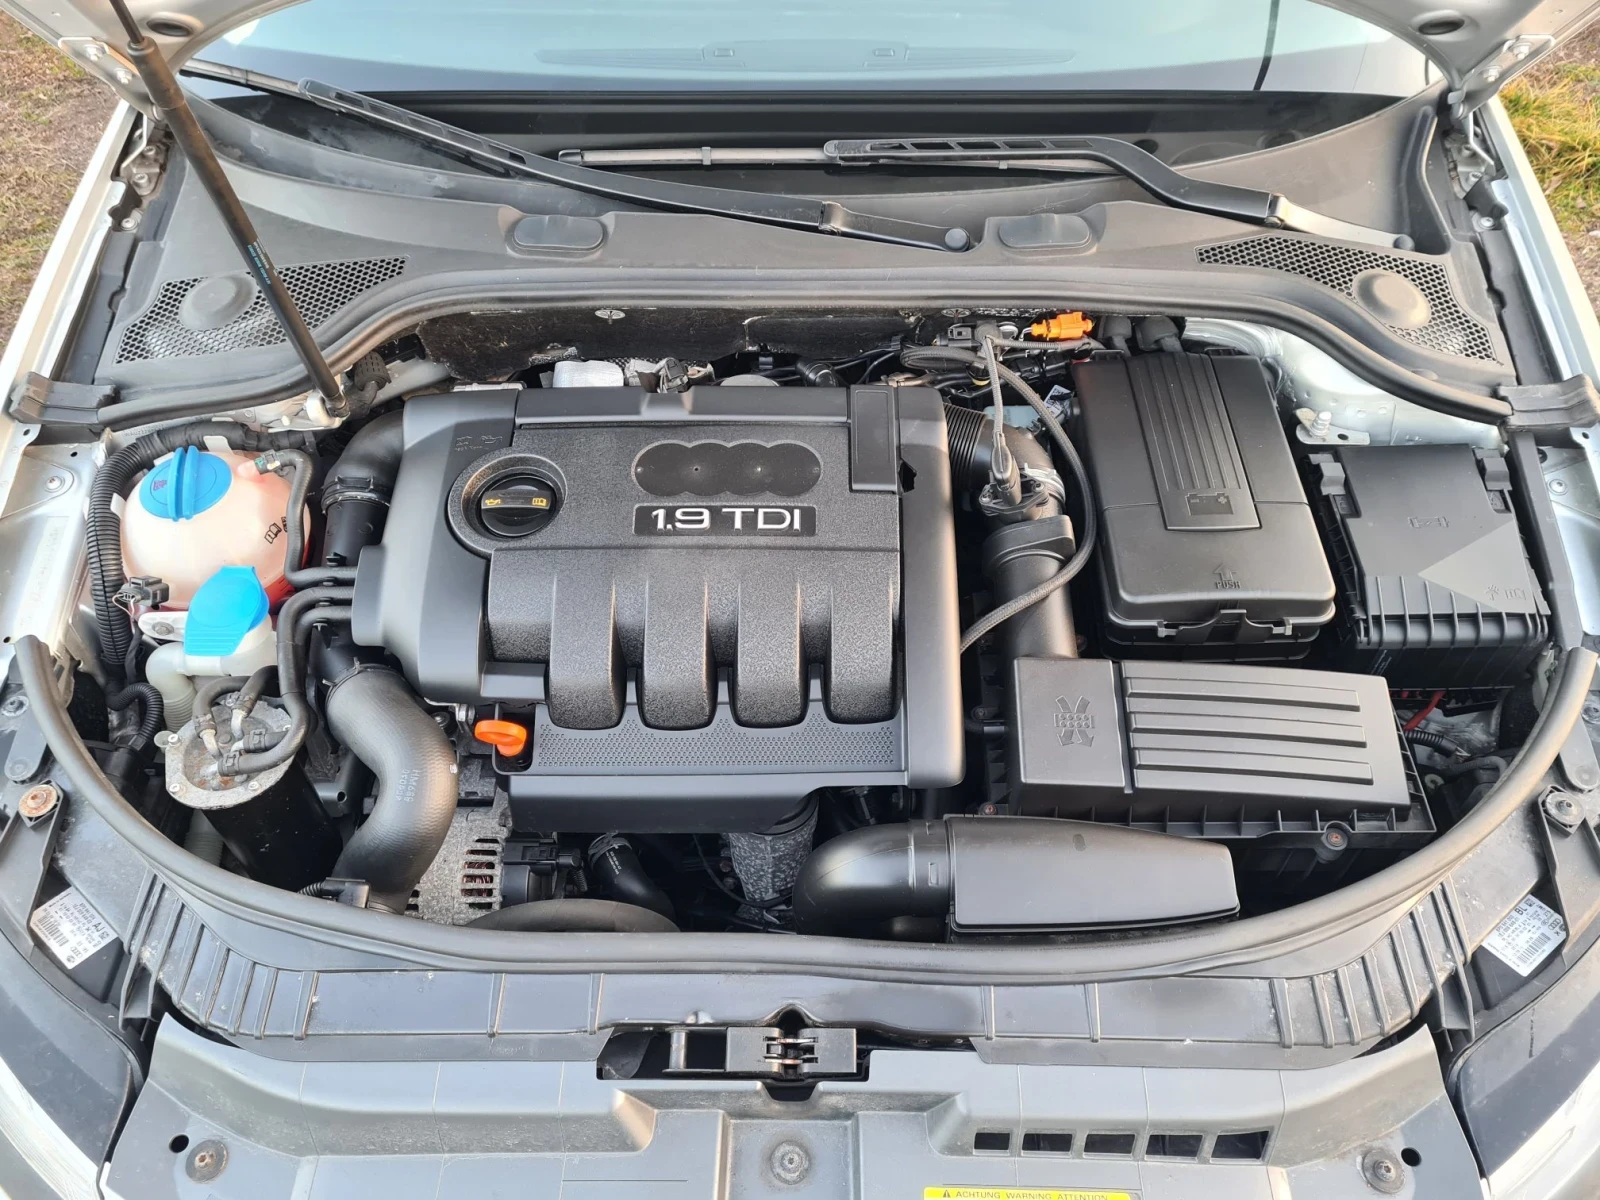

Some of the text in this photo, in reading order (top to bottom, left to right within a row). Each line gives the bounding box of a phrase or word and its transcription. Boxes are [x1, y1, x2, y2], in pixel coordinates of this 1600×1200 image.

[651, 507, 801, 532] 1.9 TDI
[1214, 580, 1241, 589] PUSH
[1514, 905, 1528, 916] BL
[956, 1191, 1001, 1199] ACHTUNG
[1006, 1192, 1052, 1200] WARNING
